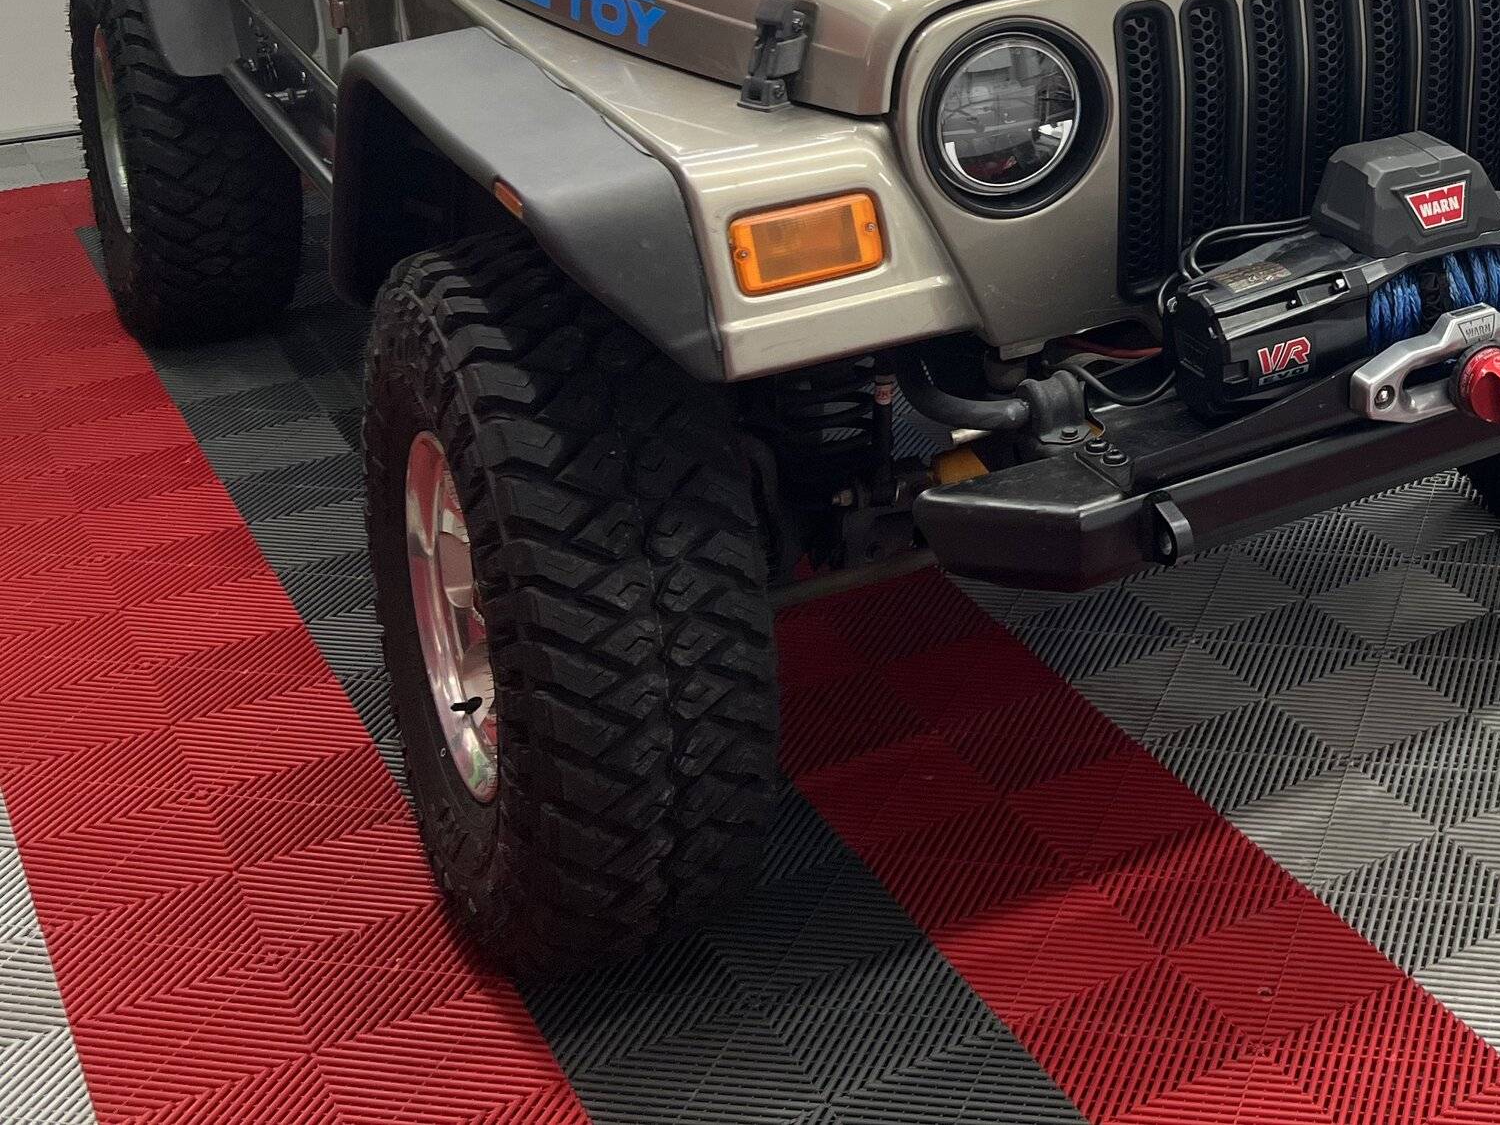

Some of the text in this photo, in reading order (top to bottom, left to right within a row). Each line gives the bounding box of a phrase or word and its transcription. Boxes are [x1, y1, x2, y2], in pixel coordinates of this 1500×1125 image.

[1419, 195, 1460, 218] WARN
[1465, 323, 1492, 337] WARN
[1257, 336, 1311, 375] VR
